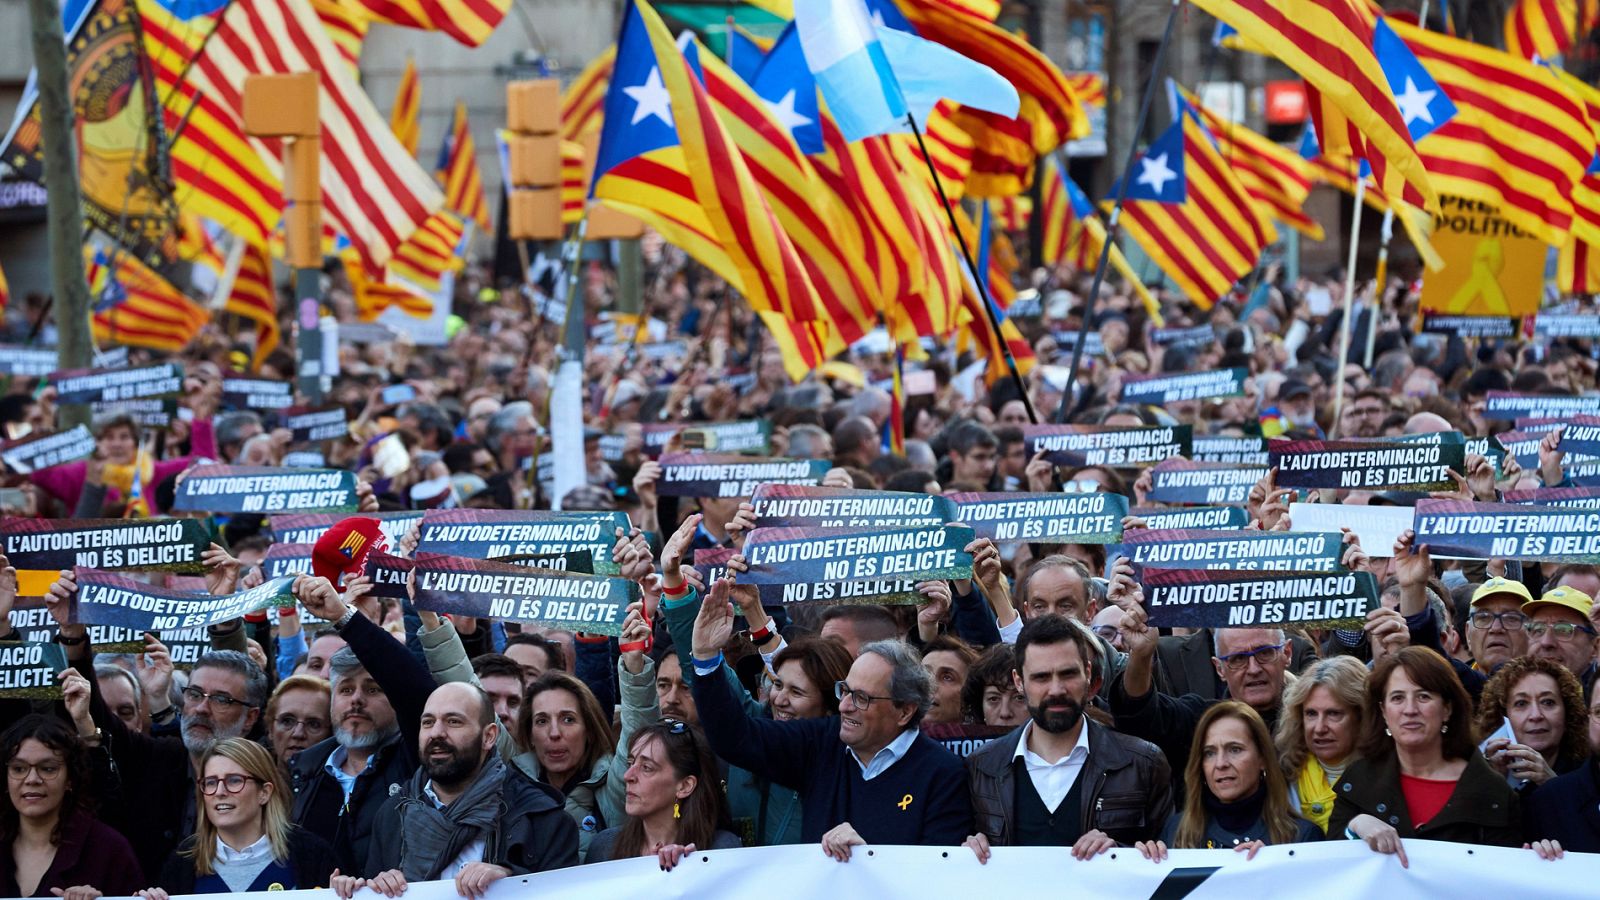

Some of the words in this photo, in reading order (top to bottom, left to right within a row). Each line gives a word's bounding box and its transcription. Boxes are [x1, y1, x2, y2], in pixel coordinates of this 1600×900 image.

[1488, 397, 1600, 410] L'AUTODETERMINACIÓ
[1034, 426, 1174, 452] L'AUTODETERMINACIÓ
[1086, 450, 1106, 466] NO
[1108, 447, 1126, 464] ÉS
[1128, 443, 1181, 462] DELICTE
[1279, 444, 1440, 471] L'AUTODETERMINACIÓ
[187, 471, 342, 496] L'AUTODETERMINACIÓ
[664, 461, 810, 482] L'AUTODETERMINACIÓ
[1341, 470, 1361, 487] NO
[1365, 466, 1385, 486] ÉS
[1388, 464, 1449, 484] DELICTE
[242, 494, 264, 511] NO
[265, 491, 286, 510] ÉS
[287, 490, 349, 509] DELICTE
[719, 482, 739, 497] NO
[1207, 489, 1226, 502] NO
[1228, 485, 1245, 501] ÉS
[754, 495, 934, 518] L'AUTODETERMINACIÓ
[7, 520, 183, 553] L'AUTODETERMINACIÓ
[424, 520, 601, 542] L'AUTODETERMINACIÓ
[995, 522, 1017, 540] NO
[1023, 517, 1043, 538] ÉS
[1047, 515, 1114, 536] DELICTE
[76, 552, 98, 569] NO
[103, 549, 124, 567] ÉS
[127, 543, 195, 566] DELICTE
[487, 544, 511, 559] NO
[751, 526, 947, 566] L'AUTODETERMINACIÓ
[1134, 533, 1326, 563] L'AUTODETERMINACIÓ
[1491, 537, 1517, 556] NO
[1522, 534, 1546, 554] ÉS
[824, 560, 848, 580] NO
[854, 555, 877, 577] ÉS
[881, 549, 957, 575] DELICTE
[422, 571, 611, 599] L'AUTODETERMINACIÓ
[783, 584, 806, 602] NO
[840, 579, 914, 597] DELICTE
[1151, 571, 1356, 606] L'AUTODETERMINACIÓ
[151, 616, 178, 630] NO
[182, 612, 207, 627] ÉS
[210, 585, 280, 621] DELICTE
[489, 598, 514, 618] NO
[518, 596, 540, 618] ÉS
[544, 600, 619, 623] DELICTE
[1229, 606, 1255, 625] NO
[1259, 600, 1284, 623] ÉS
[1289, 597, 1368, 622] DELICTE
